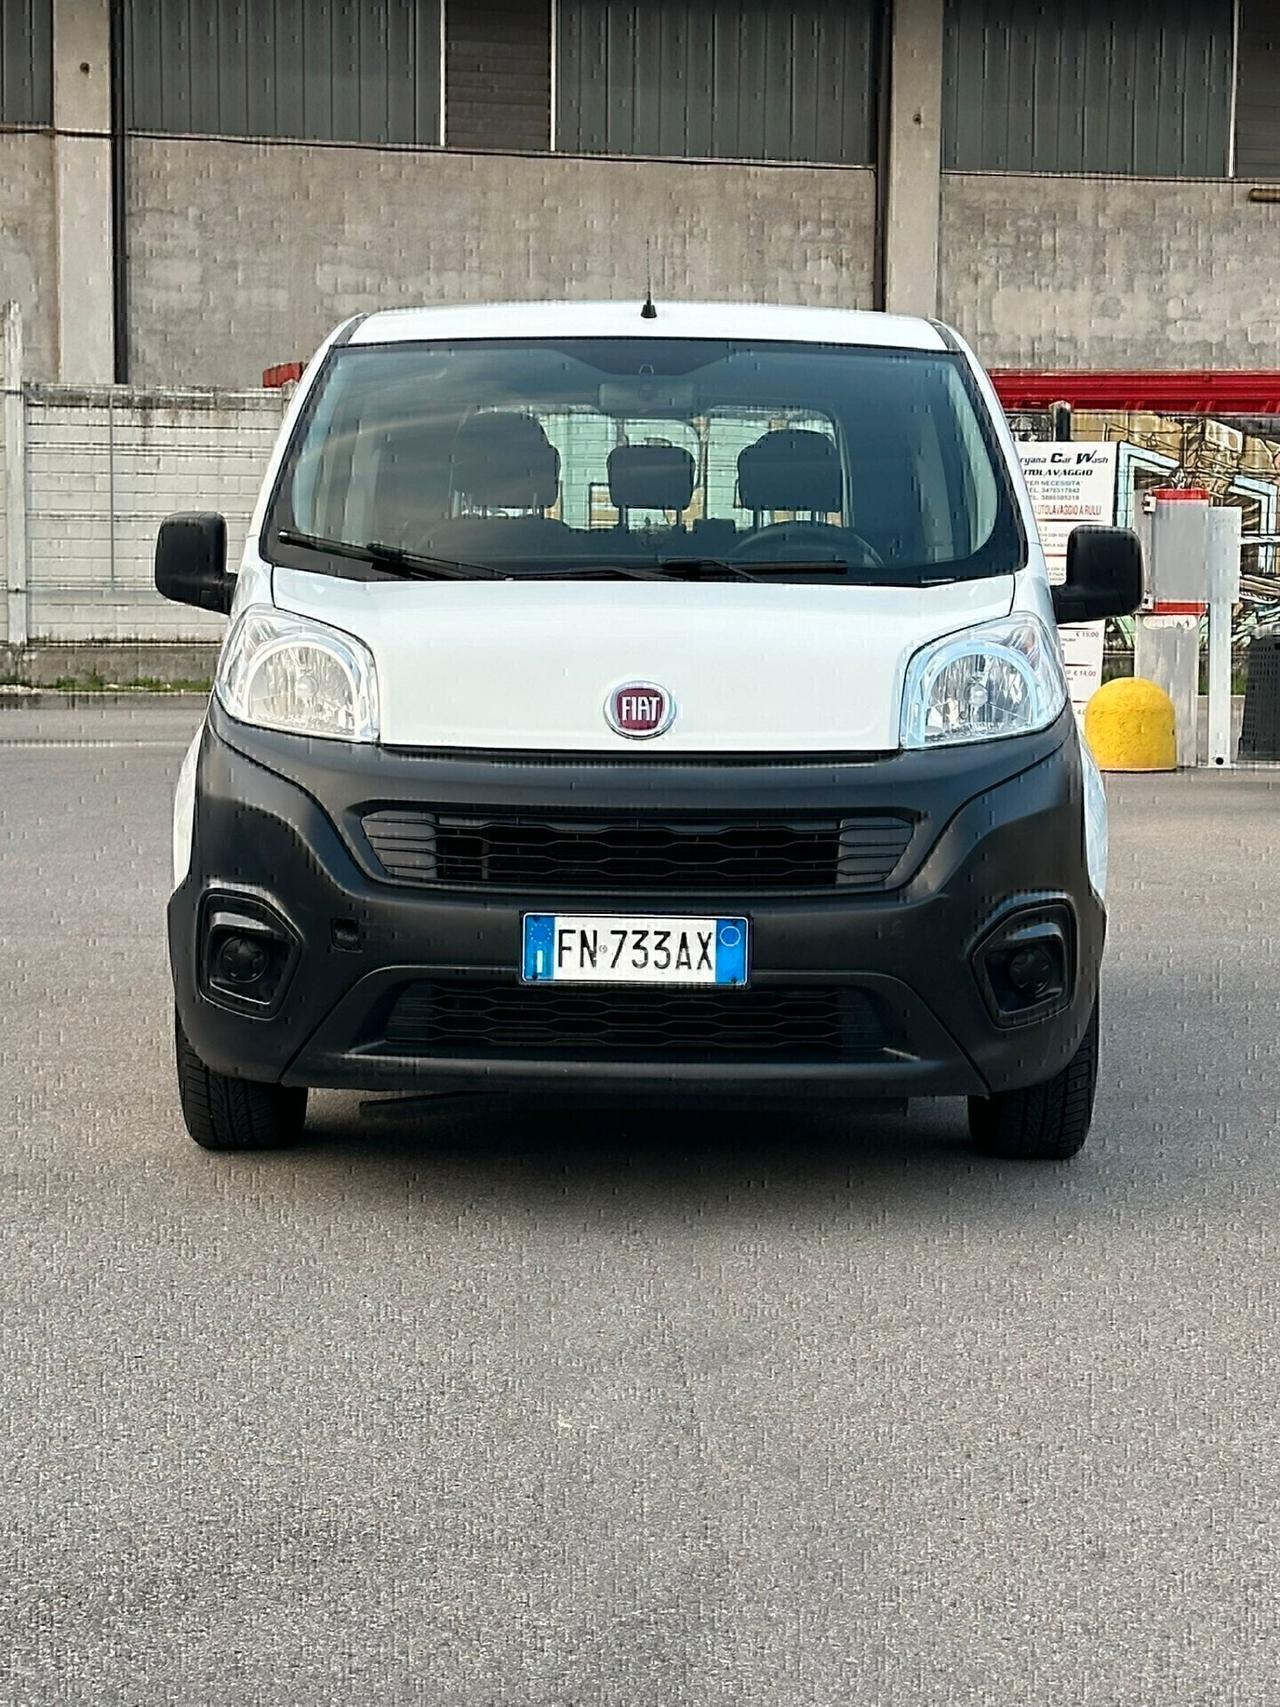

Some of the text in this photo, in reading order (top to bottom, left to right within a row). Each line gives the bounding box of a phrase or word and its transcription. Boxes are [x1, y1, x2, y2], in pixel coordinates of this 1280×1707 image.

[1050, 452, 1072, 464] Car
[1076, 449, 1109, 465] Wash
[621, 696, 660, 721] FIAT
